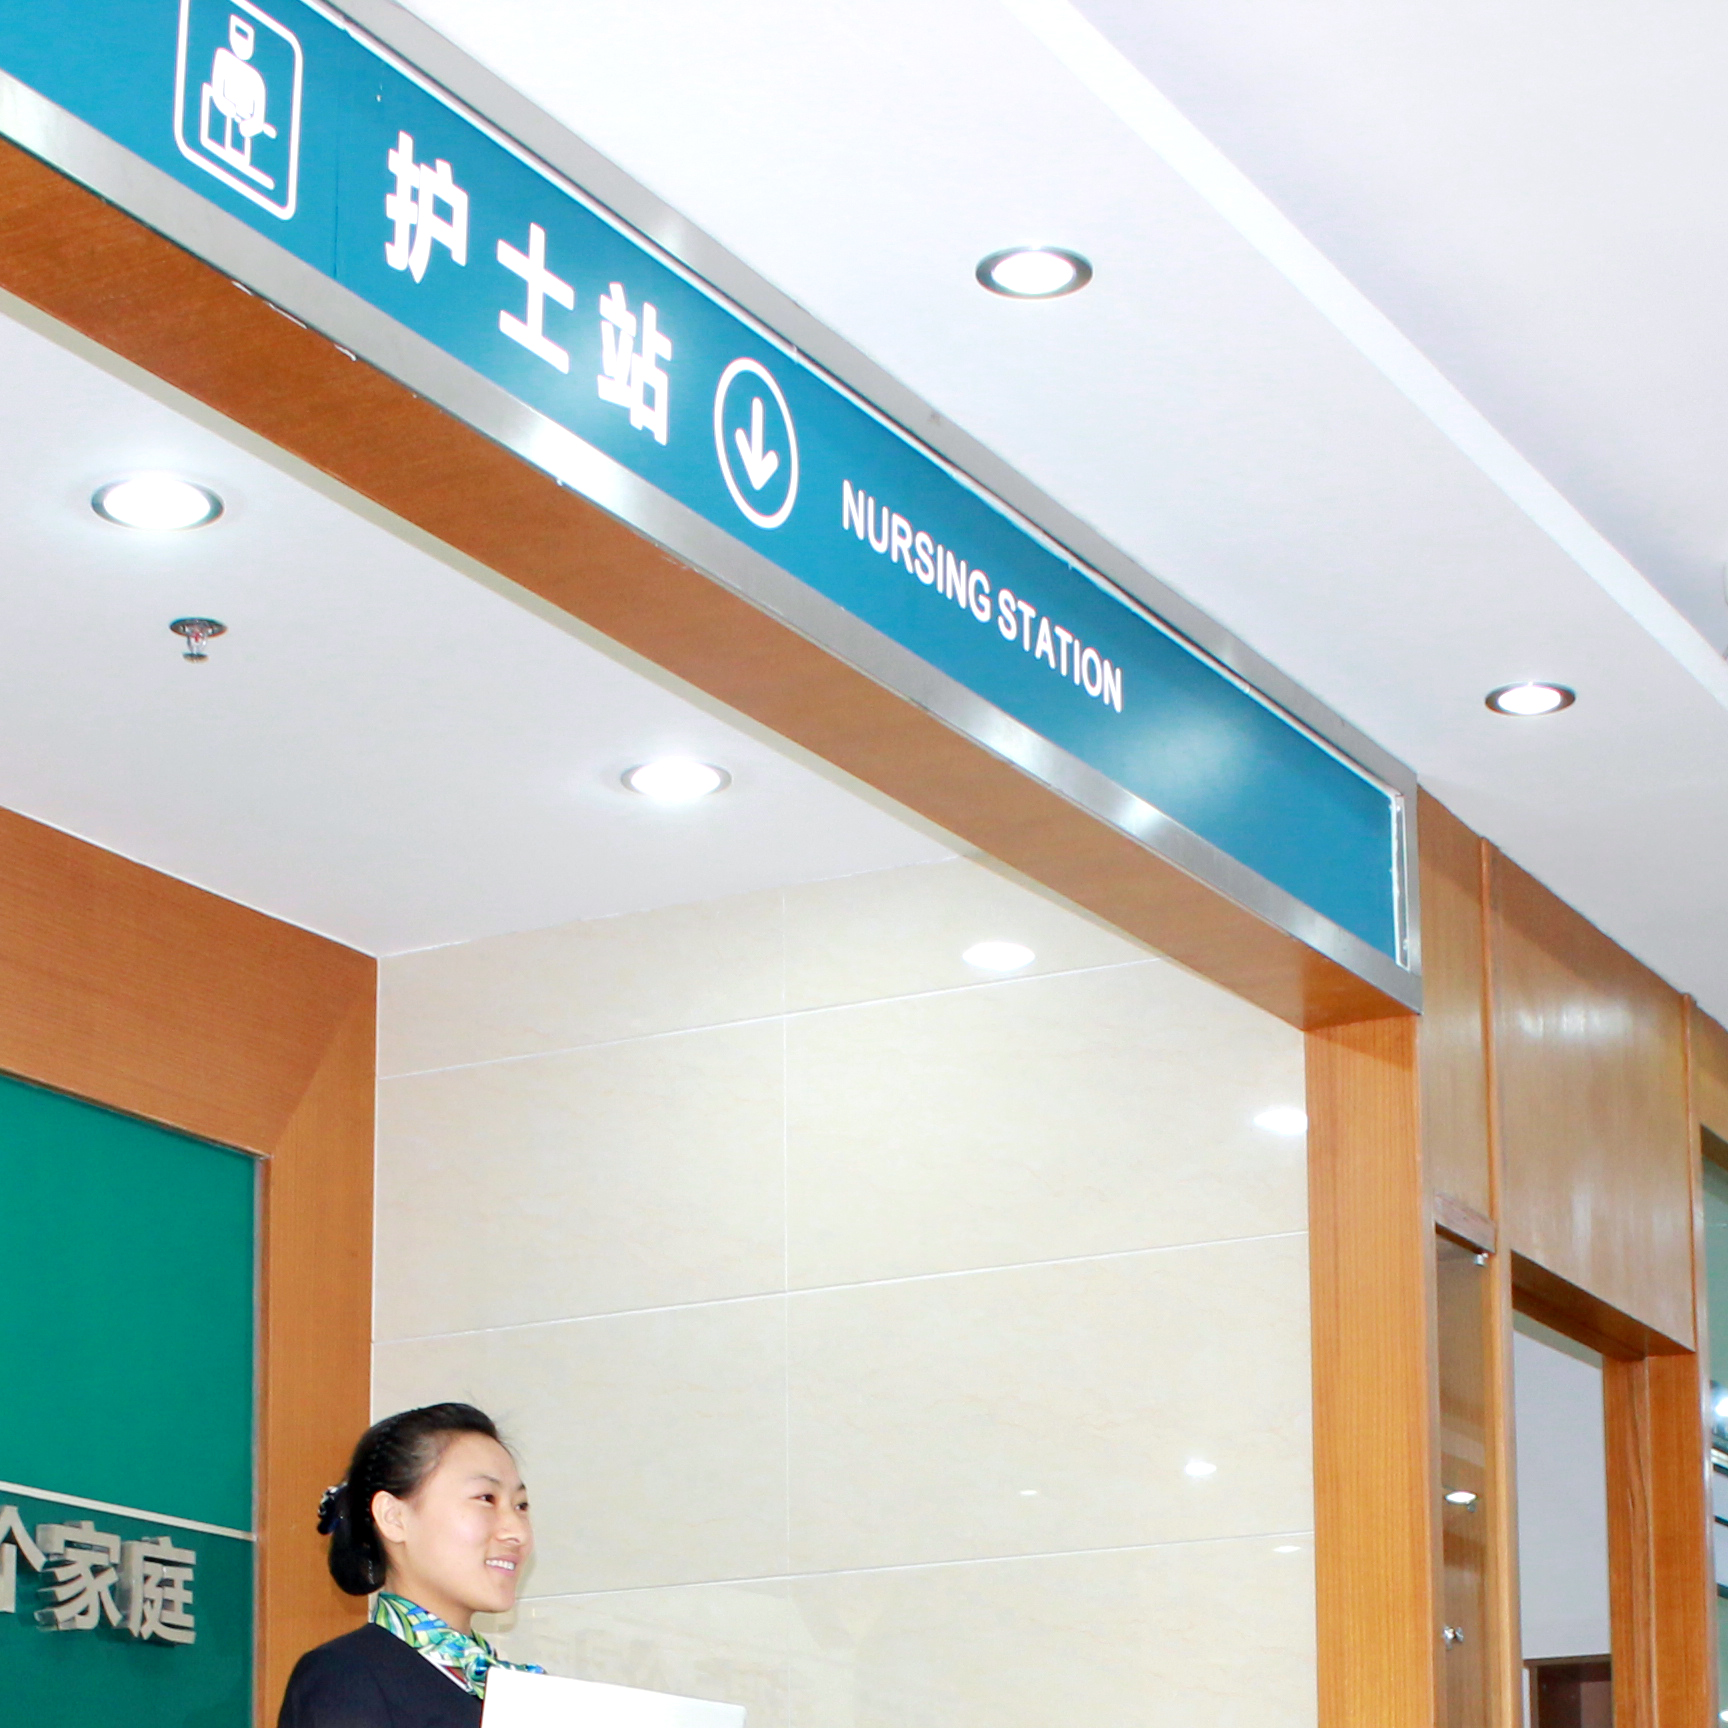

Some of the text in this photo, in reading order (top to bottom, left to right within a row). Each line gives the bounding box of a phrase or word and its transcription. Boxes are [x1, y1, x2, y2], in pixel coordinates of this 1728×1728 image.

[384, 129, 672, 446] 护士站
[842, 479, 1122, 713] NURSING STATION
